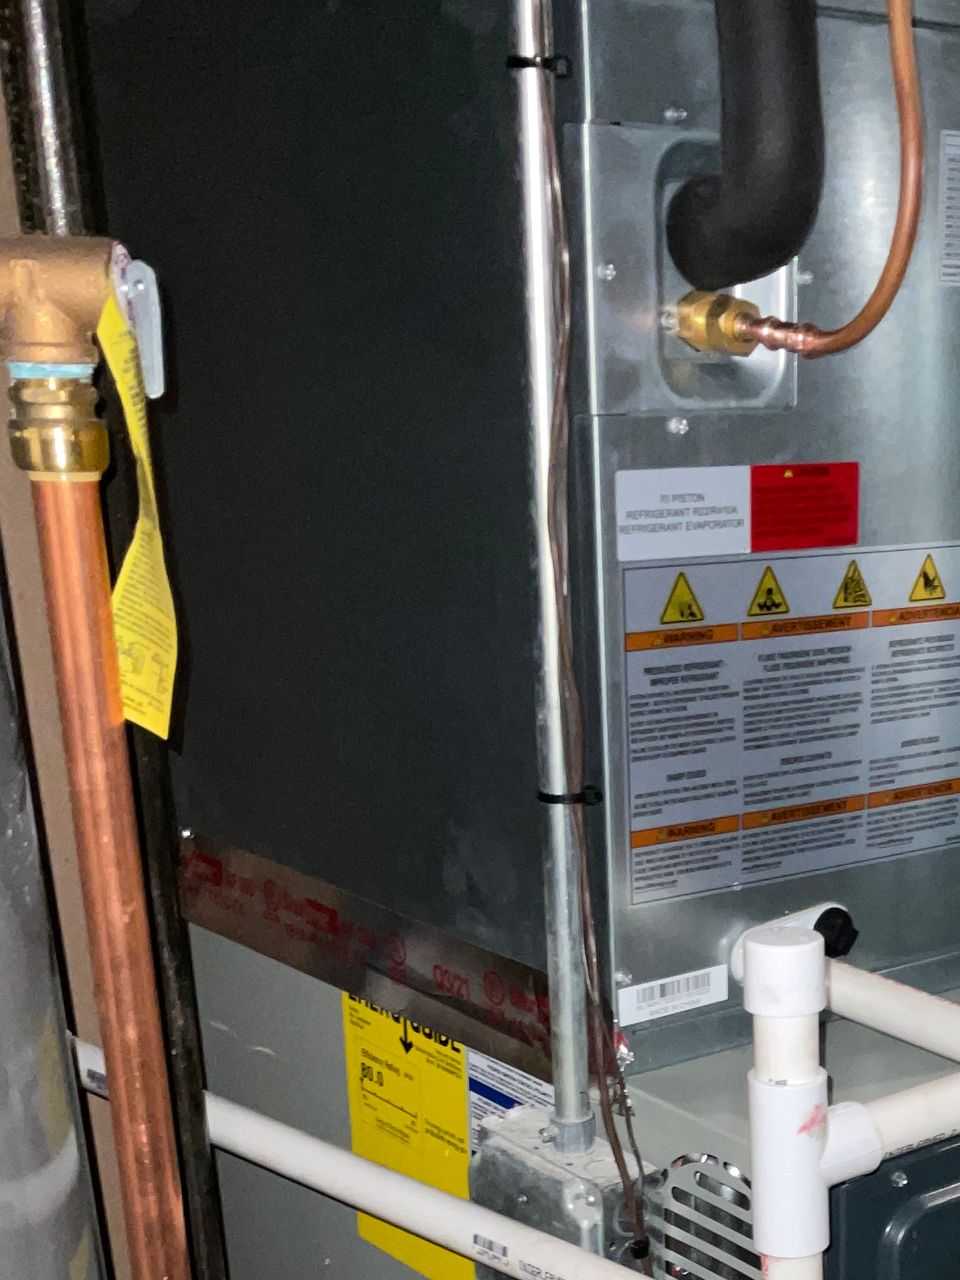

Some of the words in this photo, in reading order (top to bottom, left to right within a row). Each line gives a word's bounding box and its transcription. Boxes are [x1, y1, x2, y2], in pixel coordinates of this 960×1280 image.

[626, 507, 691, 520] REFRIGERANT
[619, 521, 685, 534] REFRIGERANT
[686, 519, 745, 532] EVAPORATOR
[663, 629, 713, 643] WARNING
[667, 822, 716, 838] WARNING
